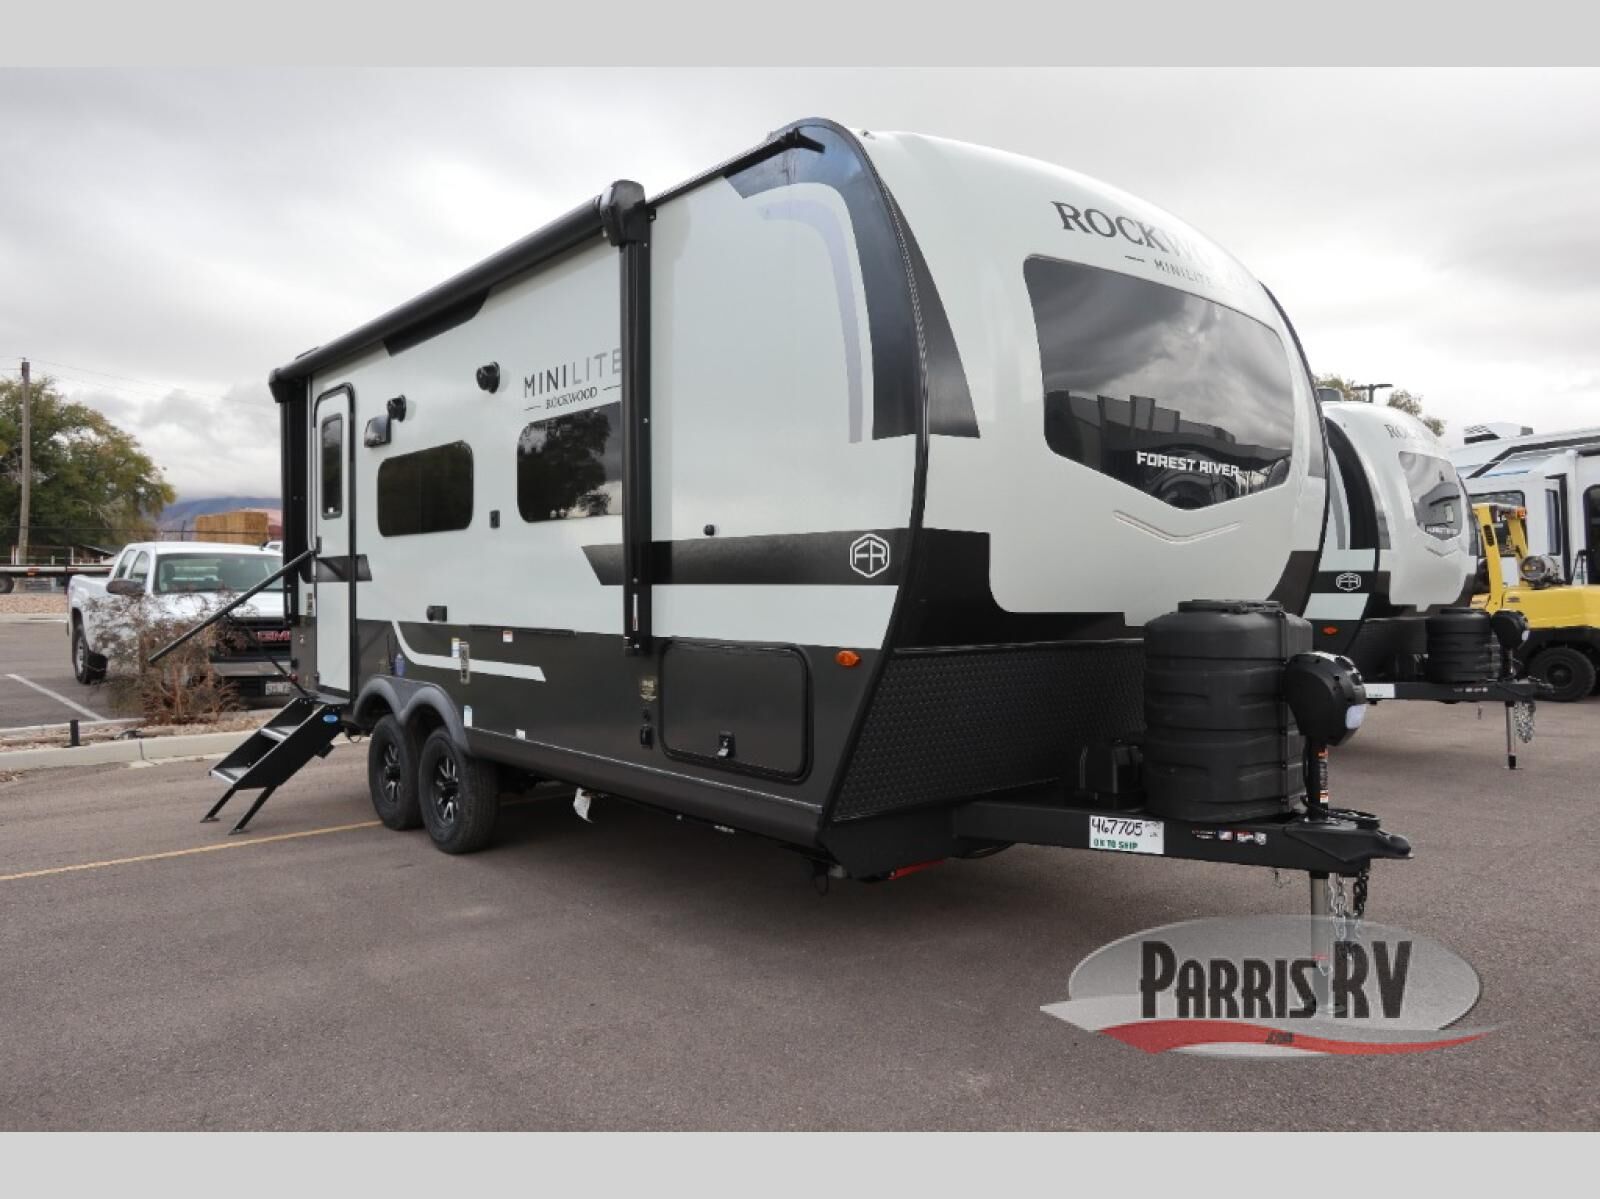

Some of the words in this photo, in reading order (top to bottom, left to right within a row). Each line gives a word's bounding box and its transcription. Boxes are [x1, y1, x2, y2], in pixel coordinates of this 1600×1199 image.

[523, 347, 621, 398] MINILITE
[546, 386, 597, 409] ROCKWOOD
[1136, 451, 1196, 471] FOREST
[1200, 460, 1239, 477] RIVER
[257, 630, 290, 641] GM
[1092, 818, 1142, 836] 467705
[1094, 839, 1105, 847] OK
[1107, 840, 1116, 848] TO
[1119, 841, 1138, 849] SHIP
